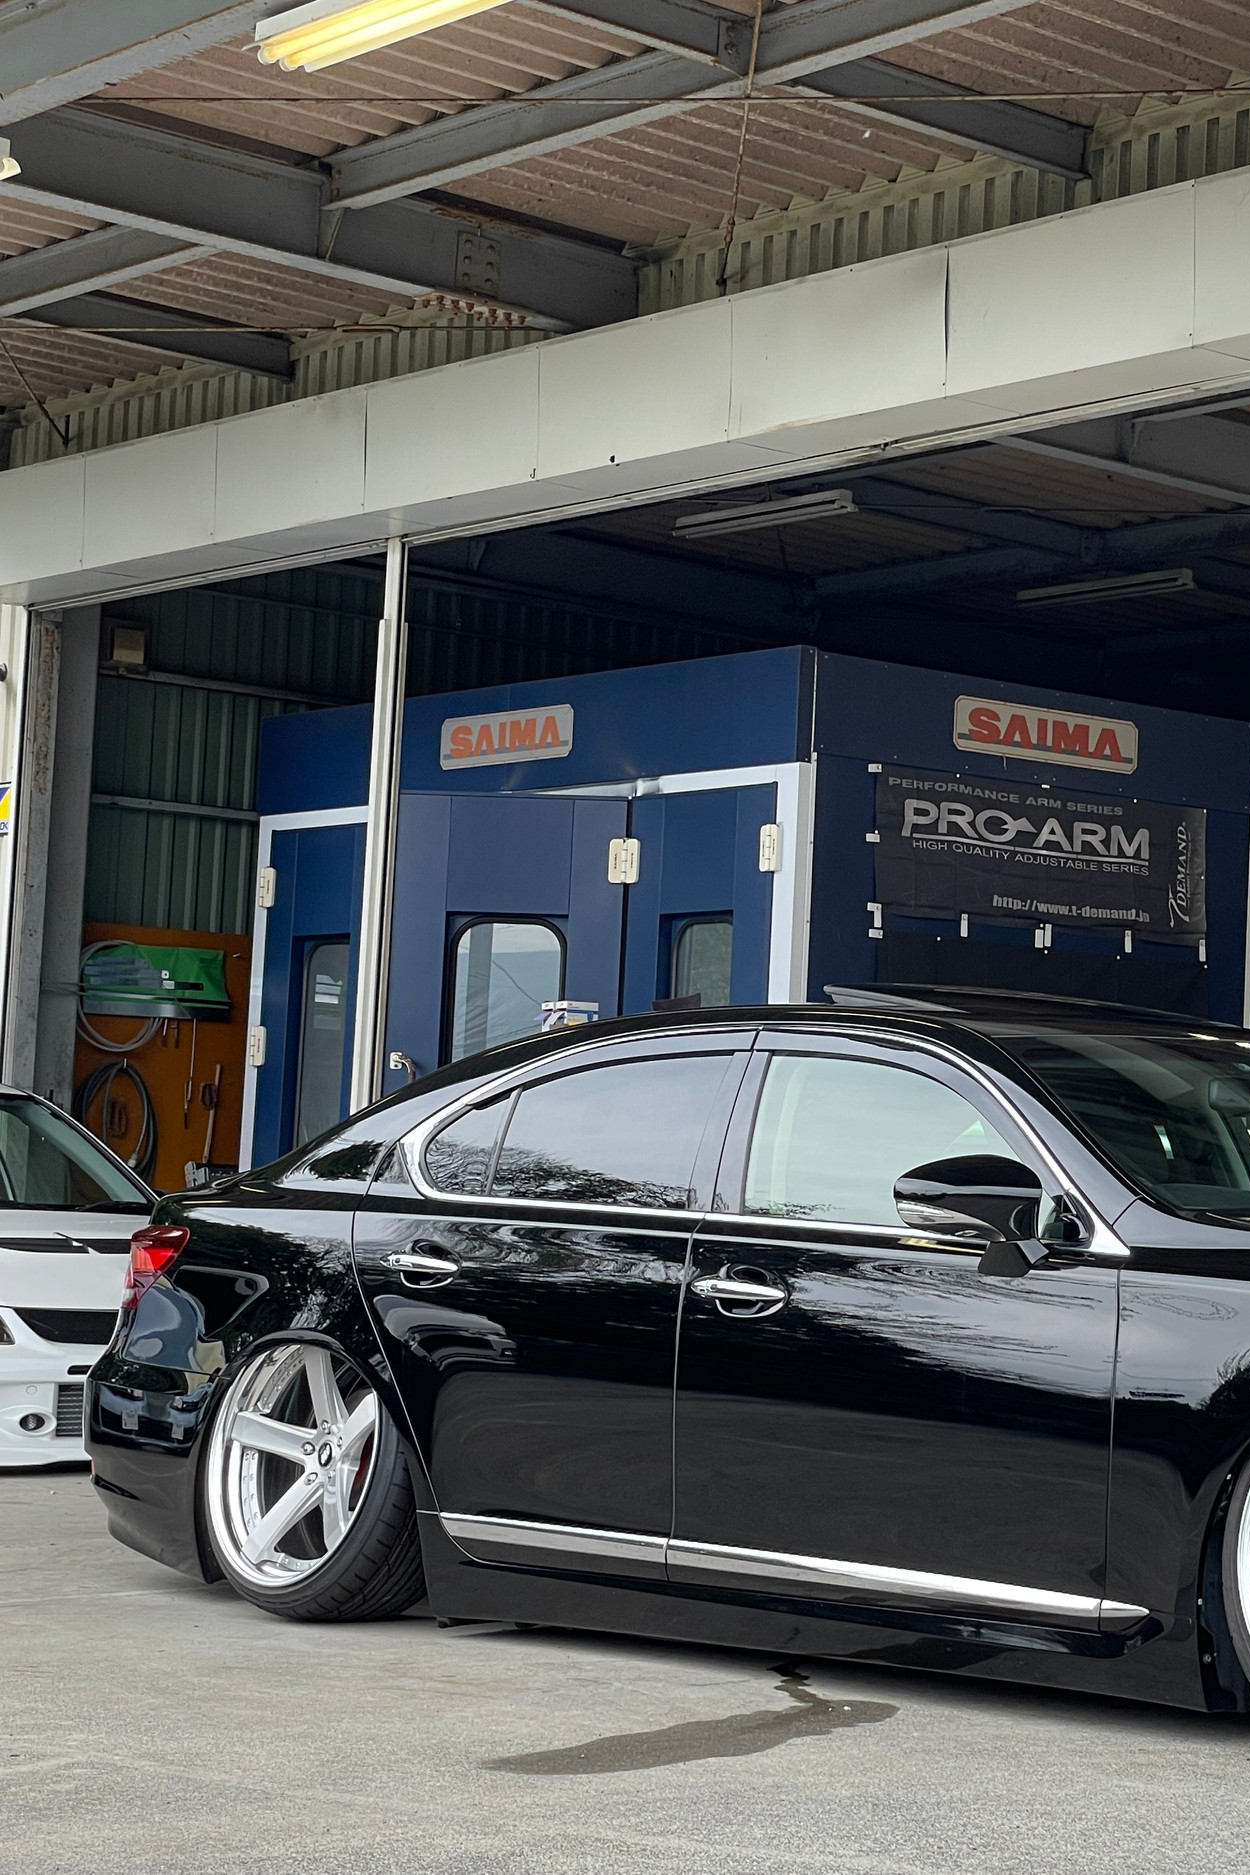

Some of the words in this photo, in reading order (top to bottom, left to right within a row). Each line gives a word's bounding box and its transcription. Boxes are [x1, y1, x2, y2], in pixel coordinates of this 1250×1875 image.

[450, 715, 562, 759] SAIMA
[968, 706, 1123, 763] SAIMA
[888, 776, 1020, 804] PERFORMANCE
[1025, 796, 1062, 809] ARM
[1066, 801, 1123, 815] SERIES
[913, 839, 948, 850] HIGH
[952, 843, 1010, 860] QUALITY
[1014, 852, 1098, 871] ADJUSTABLE
[1102, 863, 1149, 876] SERIES
